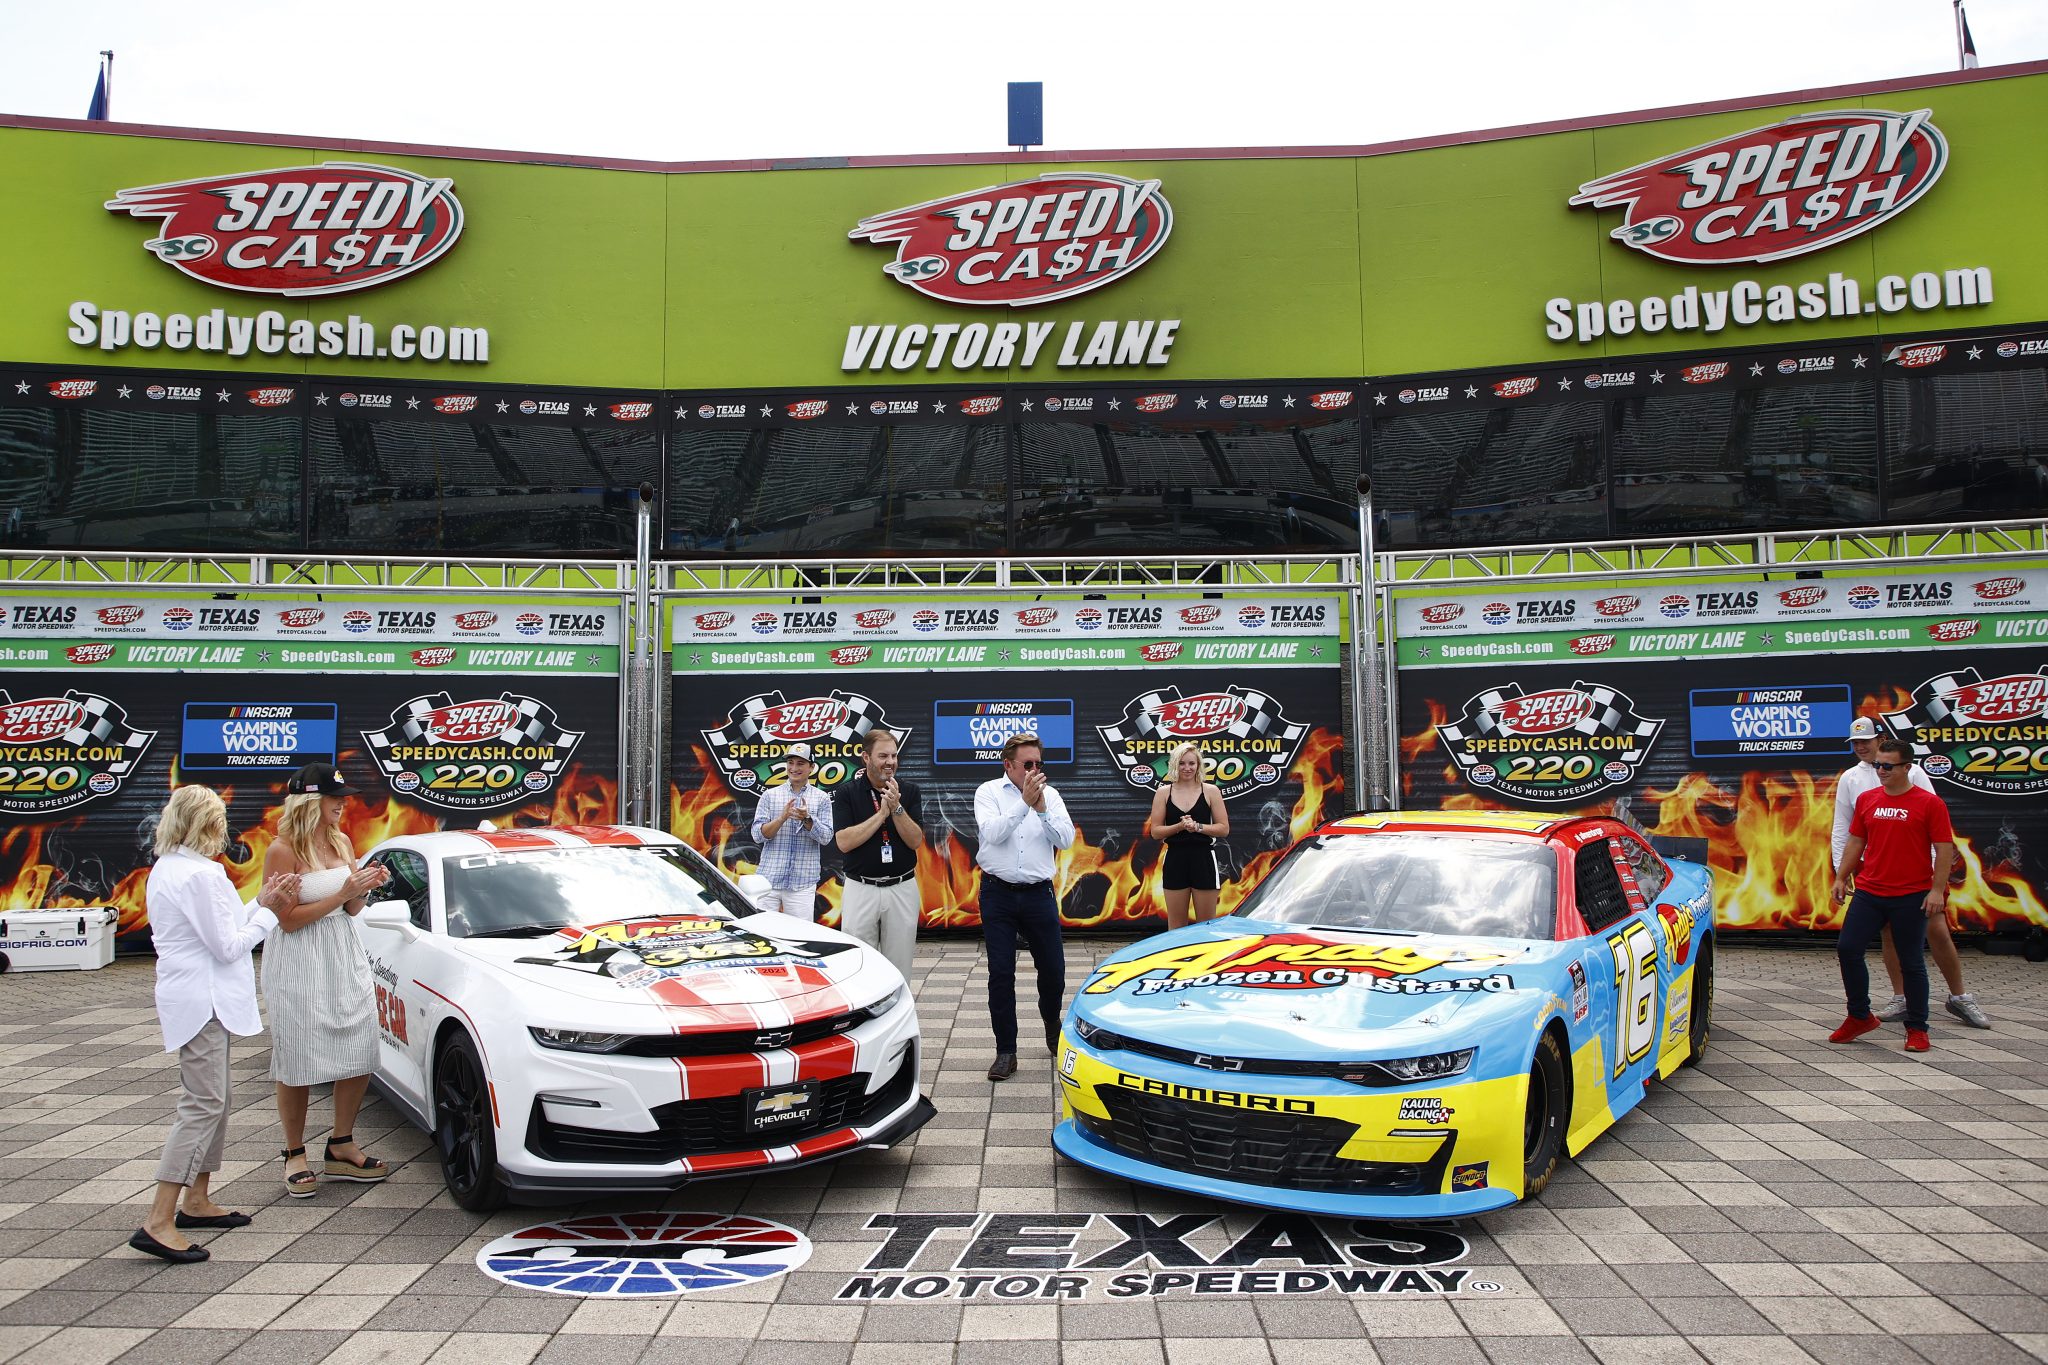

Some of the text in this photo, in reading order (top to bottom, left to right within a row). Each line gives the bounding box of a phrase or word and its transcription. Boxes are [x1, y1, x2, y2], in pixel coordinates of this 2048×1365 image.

[1668, 108, 1932, 212] SPEEDY
[210, 178, 453, 231] SPEEDY
[1691, 173, 1908, 245] CA$H
[940, 180, 1162, 253] SPEEDY
[1630, 219, 1677, 242] SC
[160, 238, 208, 256] SC
[223, 229, 427, 274] CA$H
[900, 259, 942, 278] SC
[956, 237, 1139, 286] CA$H
[1545, 265, 1995, 344] SpeedyCash.com
[67, 301, 490, 364] SpeedyCash.com
[841, 319, 1181, 373] VICTORY LANE
[1905, 345, 1945, 360] SPEEDY
[1799, 356, 1835, 368] TEXAS
[60, 380, 97, 391] SPEEDY
[167, 387, 201, 397] TEXAS
[1417, 387, 1449, 397] TEXAS
[716, 404, 746, 415] TEXAS
[1696, 590, 1759, 609] TEXAS
[1886, 582, 1953, 601] TEXAS
[1271, 605, 1325, 621] TEXAS
[1516, 599, 1576, 617] TEXAS
[1696, 608, 1756, 617] MOTOR SPEEDWAY
[1887, 600, 1950, 609] MOTOR SPEEDWAY
[12, 606, 77, 622] TEXAS
[200, 608, 260, 625] TEXAS
[377, 611, 436, 627] TEXAS
[549, 613, 605, 630] TEXAS
[783, 611, 837, 626] TEXAS
[945, 608, 999, 625] TEXAS
[1108, 607, 1162, 623] TEXAS
[571, 629, 603, 637] SPEEDWAY
[1938, 620, 1979, 632] SPEEDY
[1995, 619, 2048, 637] VICTO
[1629, 631, 1747, 651] VICTORY LANE
[1785, 628, 1910, 644] SpeedyCash.com
[76, 644, 115, 655] SPEEDY
[127, 646, 245, 663] VICTORY LANE
[836, 646, 871, 656] SPEEDY
[883, 646, 987, 662] VICTORY LANE
[1020, 647, 1125, 661] SpeedyCash.com
[1148, 643, 1183, 653] SPEEDY
[1194, 643, 1299, 660] VICTORY LANE
[1441, 642, 1553, 657] SpeedyCash.com
[281, 650, 395, 664] SpeedyCash.com
[468, 649, 577, 666] VICTORY LANE
[711, 651, 815, 665] SpeedyCash.com
[1518, 692, 1589, 716] SPEEDY
[1752, 690, 1803, 703] NASCAR
[3, 702, 83, 724] SPEEDY
[244, 706, 293, 718] NASCAR
[446, 704, 517, 723] SPEEDY
[779, 702, 845, 723] SPEEDY
[989, 703, 1033, 714] NASCAR
[1176, 697, 1243, 718] SPEEDY
[1730, 704, 1810, 722] CAMPING
[782, 718, 839, 735] CA$H
[969, 717, 1038, 731] CAMPING
[1178, 713, 1238, 730] CA$H
[1521, 710, 1584, 728] CA$H
[6, 720, 75, 737] CA$H
[222, 721, 297, 736] CAMPING
[449, 721, 509, 737] CA$H
[1731, 719, 1811, 738] WORLD
[1916, 726, 2048, 743] SPEEDYCASH
[223, 735, 297, 751] WORLD
[729, 744, 863, 759] SPEEDYSH.CO
[1465, 735, 1634, 754] SPEEDYCASH.COM
[1738, 739, 1805, 752] TRUCK SERIES
[0, 747, 123, 761] YCASH.COM
[226, 755, 290, 765] TRUCK SERIES
[391, 746, 554, 761] SPEEDYCASH.COM
[975, 750, 1003, 760] TRUCK
[428, 763, 515, 790] 220
[1505, 754, 1596, 782] 220
[0, 766, 79, 792] 220
[1222, 779, 1253, 796] EEDWAY
[1496, 777, 1604, 797] TEXAS MOTOR SPEEDWAY
[1953, 771, 1983, 786] TEXAS
[1986, 781, 2021, 790] MOTOR
[3, 788, 88, 809] MOTOR SPEEDWAY
[419, 786, 524, 805] TEXAS MOTOR SPEEDWAY
[1873, 807, 1909, 819] ANDY'S
[0, 938, 88, 949] BIGFRIG.COM
[1657, 903, 1695, 973] Andy's
[762, 967, 787, 976] 2021
[1132, 967, 1519, 996] Frozen Custard
[1606, 918, 1659, 1082] 16
[1062, 1047, 1078, 1076] 16
[1117, 1073, 1315, 1116] CAMARO
[1401, 1098, 1441, 1109] KAULIG
[754, 1108, 811, 1125] CHEVROLET
[1398, 1108, 1441, 1120] RACING
[1453, 1170, 1486, 1184] SUNOCO
[861, 1211, 1470, 1272] TEXAS
[834, 1269, 1473, 1302] MOTOR SPEEDWAY
